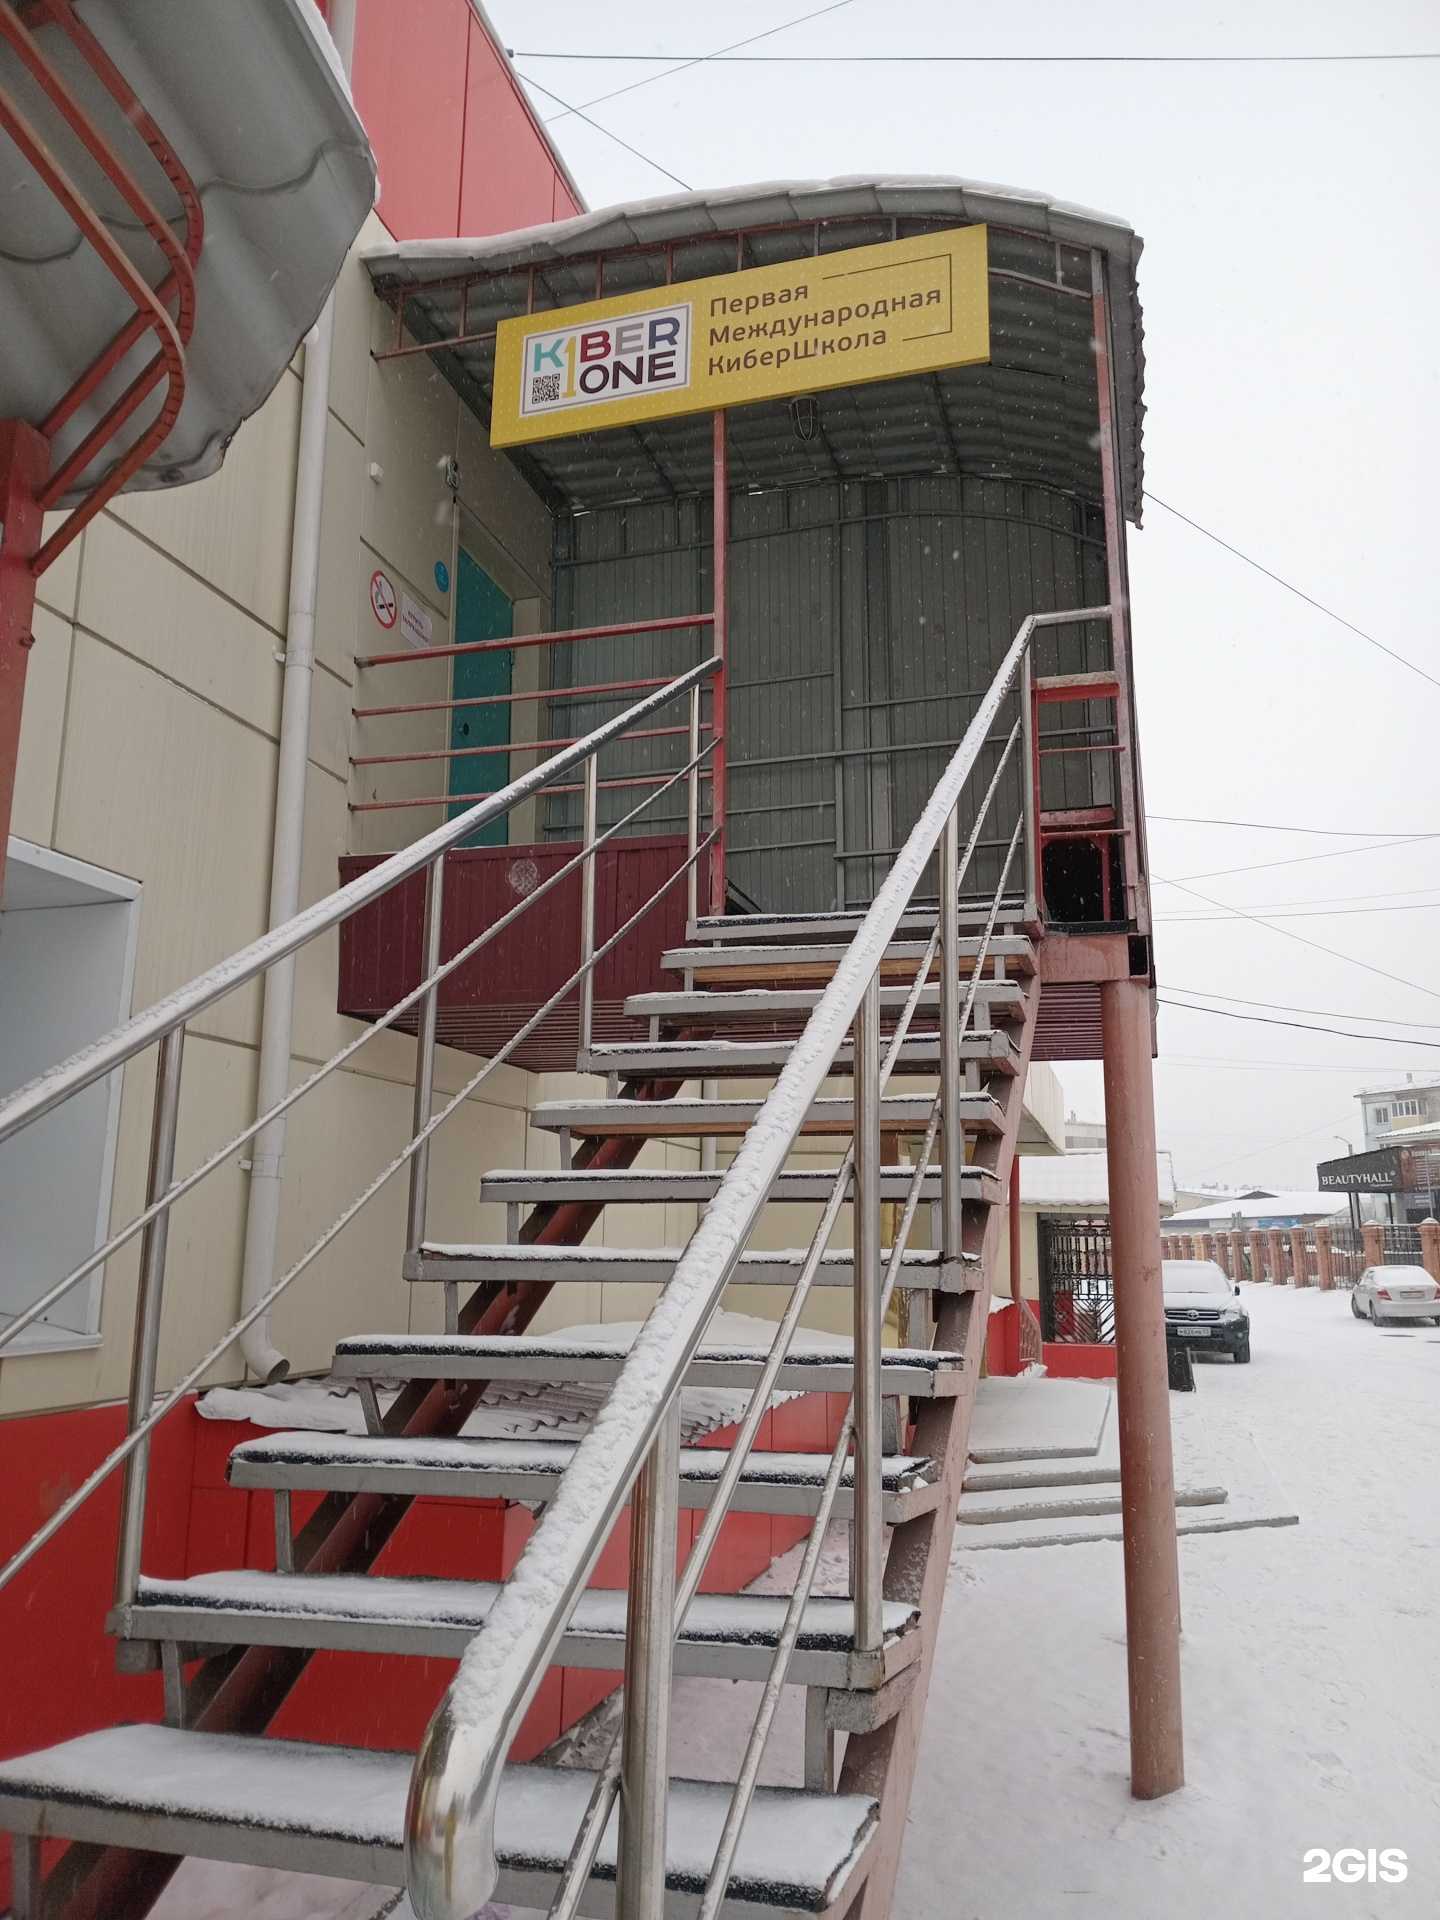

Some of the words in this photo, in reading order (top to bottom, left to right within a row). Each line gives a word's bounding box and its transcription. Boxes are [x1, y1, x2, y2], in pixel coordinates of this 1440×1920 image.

[710, 285, 808, 317] Первая
[710, 289, 941, 346] Международная
[579, 350, 676, 394] ONE
[708, 330, 887, 376] КиберШкола
[1322, 1173, 1392, 1185] BEAUTYHALL
